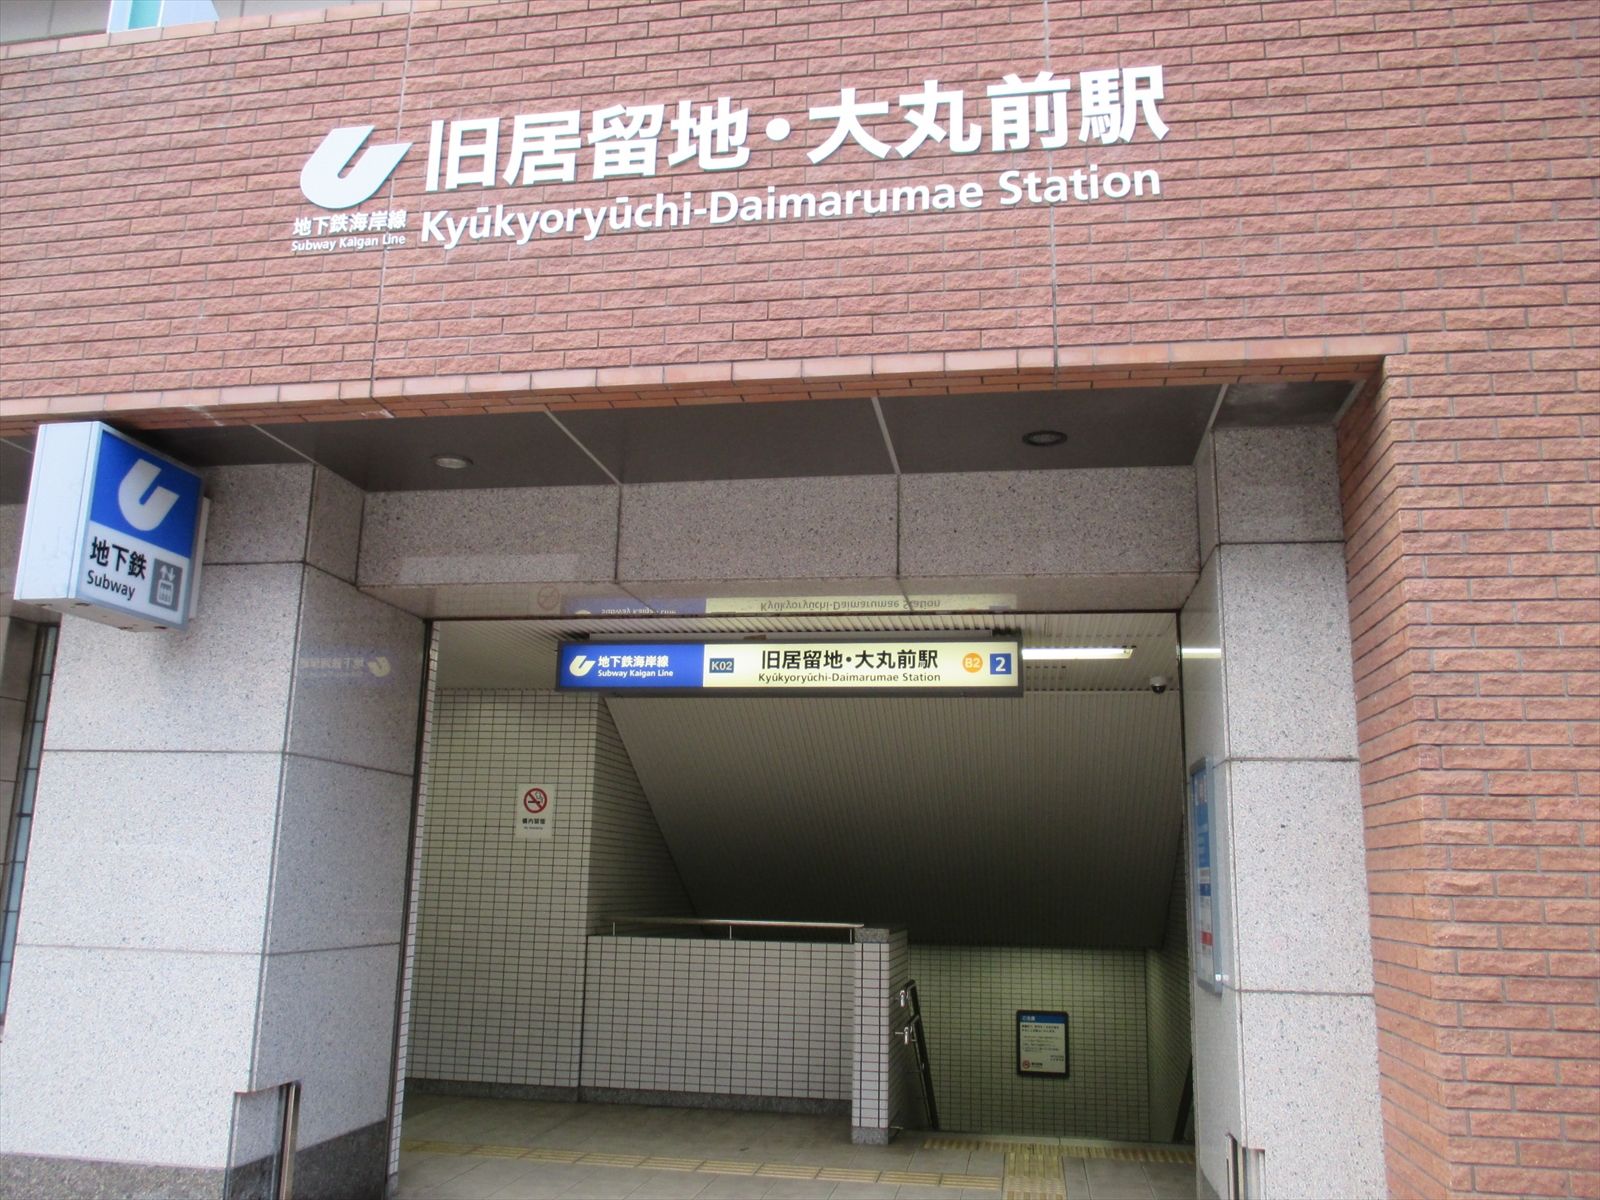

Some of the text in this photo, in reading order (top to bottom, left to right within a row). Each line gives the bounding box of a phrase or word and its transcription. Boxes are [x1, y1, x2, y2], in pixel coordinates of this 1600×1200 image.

[425, 64, 1170, 193] 旧居留地・大丸前駅
[420, 164, 1162, 250] Kyūkyoryūchi-Daimarumae Station
[292, 210, 407, 236] 地下鉄海岸線
[291, 233, 406, 252] Subway Kaigan Line
[89, 536, 147, 580] 地下鉄
[87, 570, 136, 600] Subway
[598, 655, 669, 668] 地下鉄海岸線
[710, 660, 733, 672] K02
[761, 649, 939, 670] 旧居留地・大丸前駅
[994, 657, 1006, 671] 2
[597, 669, 674, 679] Subway Kaigan Line
[902, 671, 941, 683] Station
